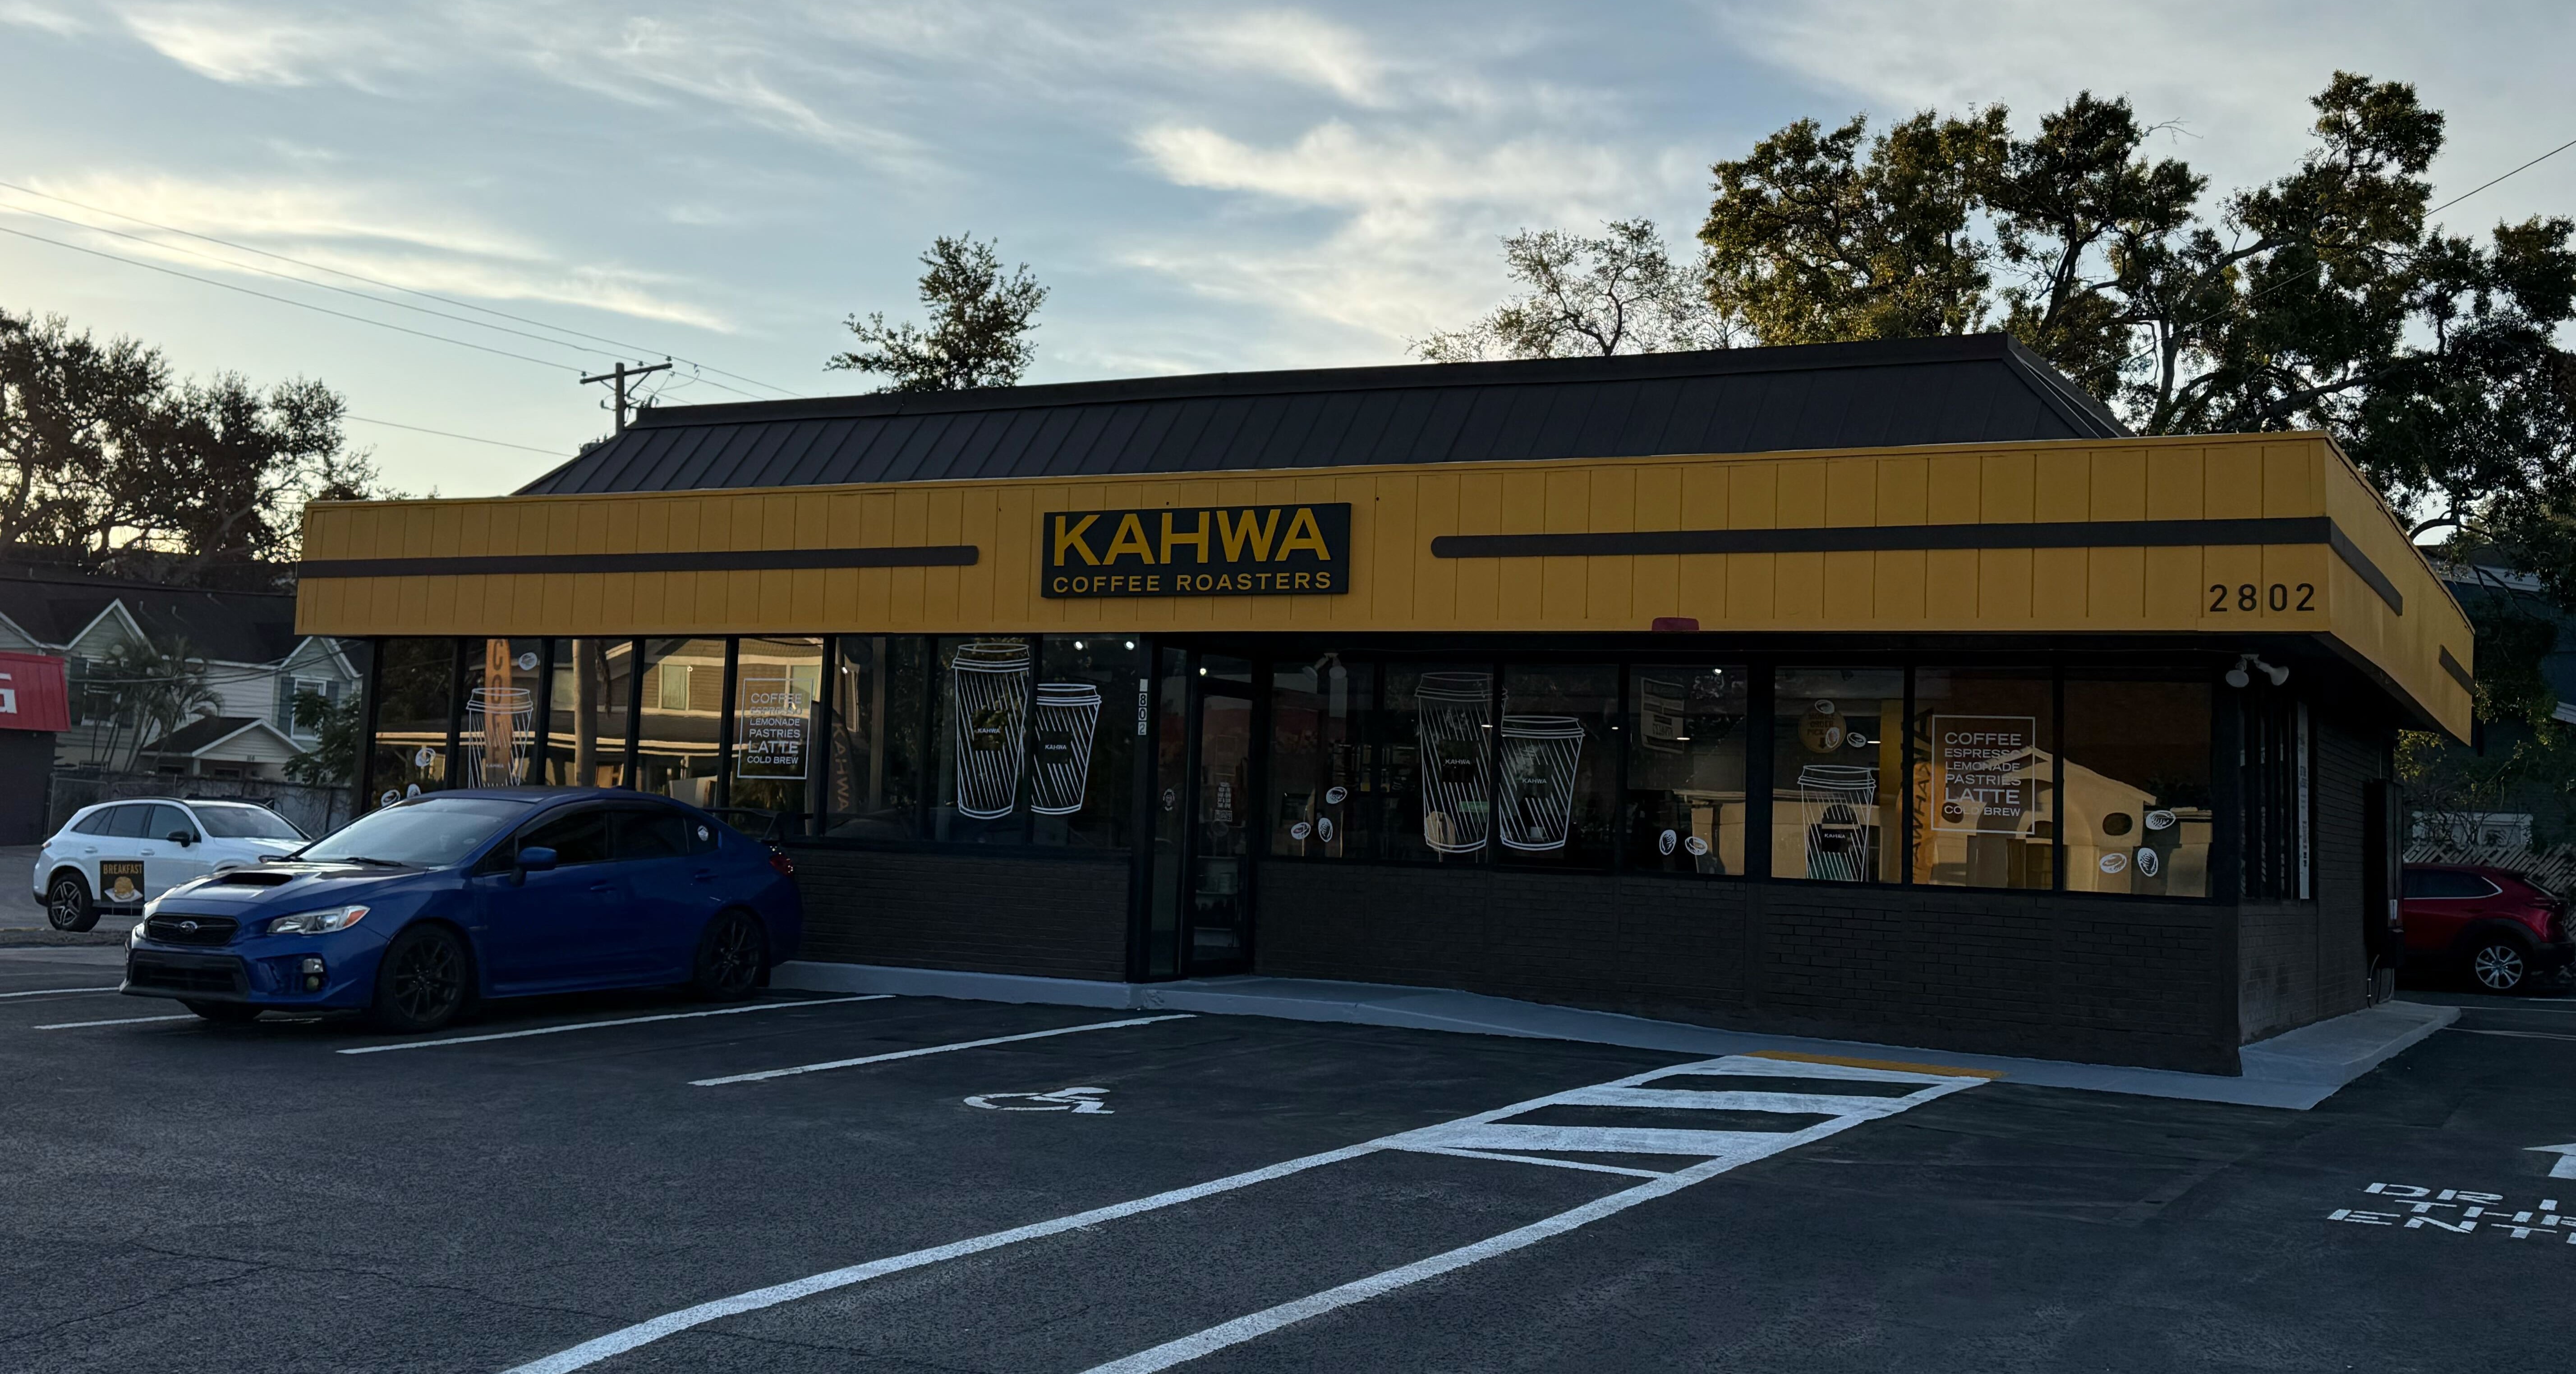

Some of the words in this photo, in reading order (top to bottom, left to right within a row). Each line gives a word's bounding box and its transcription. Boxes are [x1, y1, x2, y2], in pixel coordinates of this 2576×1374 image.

[1053, 507, 1331, 566] KAHWA
[1053, 575, 1160, 593] COFFEE
[1177, 571, 1331, 592] ROASTERS
[2209, 583, 2315, 612] 2802
[750, 693, 802, 704] COFFEE
[750, 718, 800, 726] LEMONADE
[749, 729, 801, 738] PASTRIES
[1945, 732, 2022, 746] COFFEE
[748, 740, 799, 754] LATTE
[1945, 748, 2022, 758] ESPRESSO
[832, 723, 850, 811] KAHWA
[1946, 761, 2021, 772] LEMONADE
[1945, 774, 2022, 786] PASTRIES
[1945, 787, 2020, 804] LATTE
[1944, 805, 1980, 815] COLD
[1984, 807, 2020, 816] BREW
[103, 864, 143, 874] BREAKFAST
[2327, 1208, 2576, 1245] ENT
